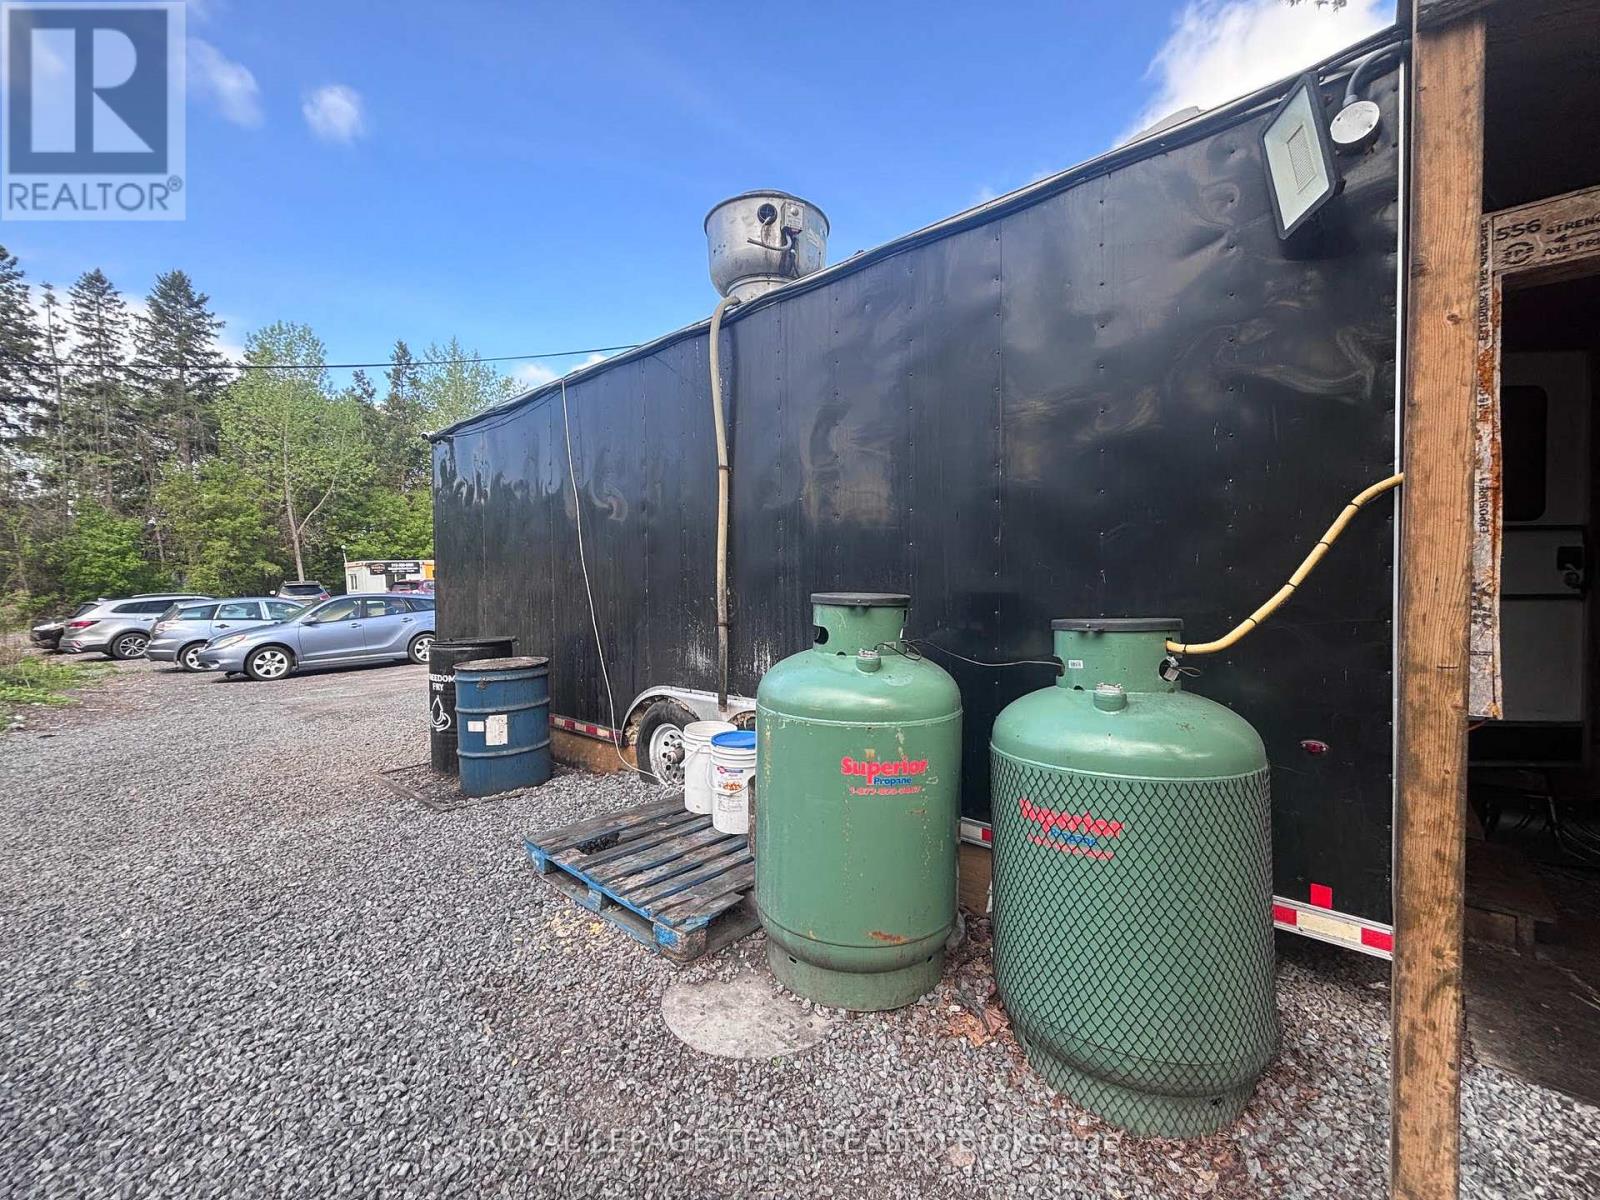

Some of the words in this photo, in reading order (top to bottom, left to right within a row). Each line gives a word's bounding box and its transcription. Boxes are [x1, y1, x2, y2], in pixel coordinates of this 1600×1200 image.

[1478, 486, 1489, 534] EXPOSURE
[432, 682, 444, 691] FRY
[841, 756, 928, 785] Superior
[873, 776, 912, 786] Propane
